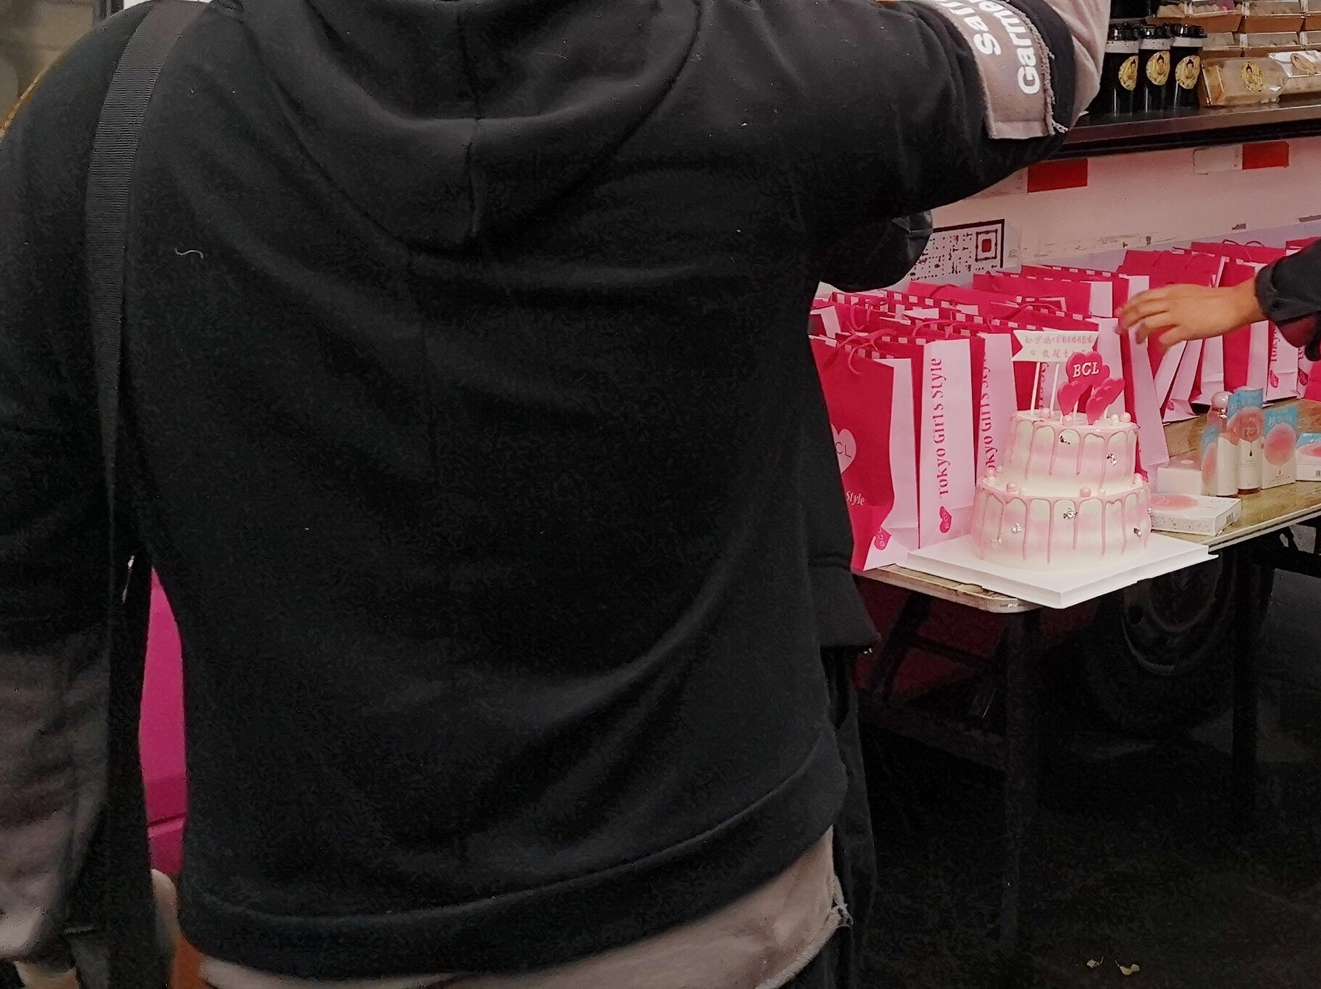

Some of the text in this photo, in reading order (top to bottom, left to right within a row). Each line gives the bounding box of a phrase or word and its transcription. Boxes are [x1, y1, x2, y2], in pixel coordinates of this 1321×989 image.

[930, 358, 947, 399] Style
[1073, 362, 1100, 378] BCL
[835, 440, 853, 459] CL
[936, 448, 951, 499] Tokyo
[846, 491, 866, 506] Style
